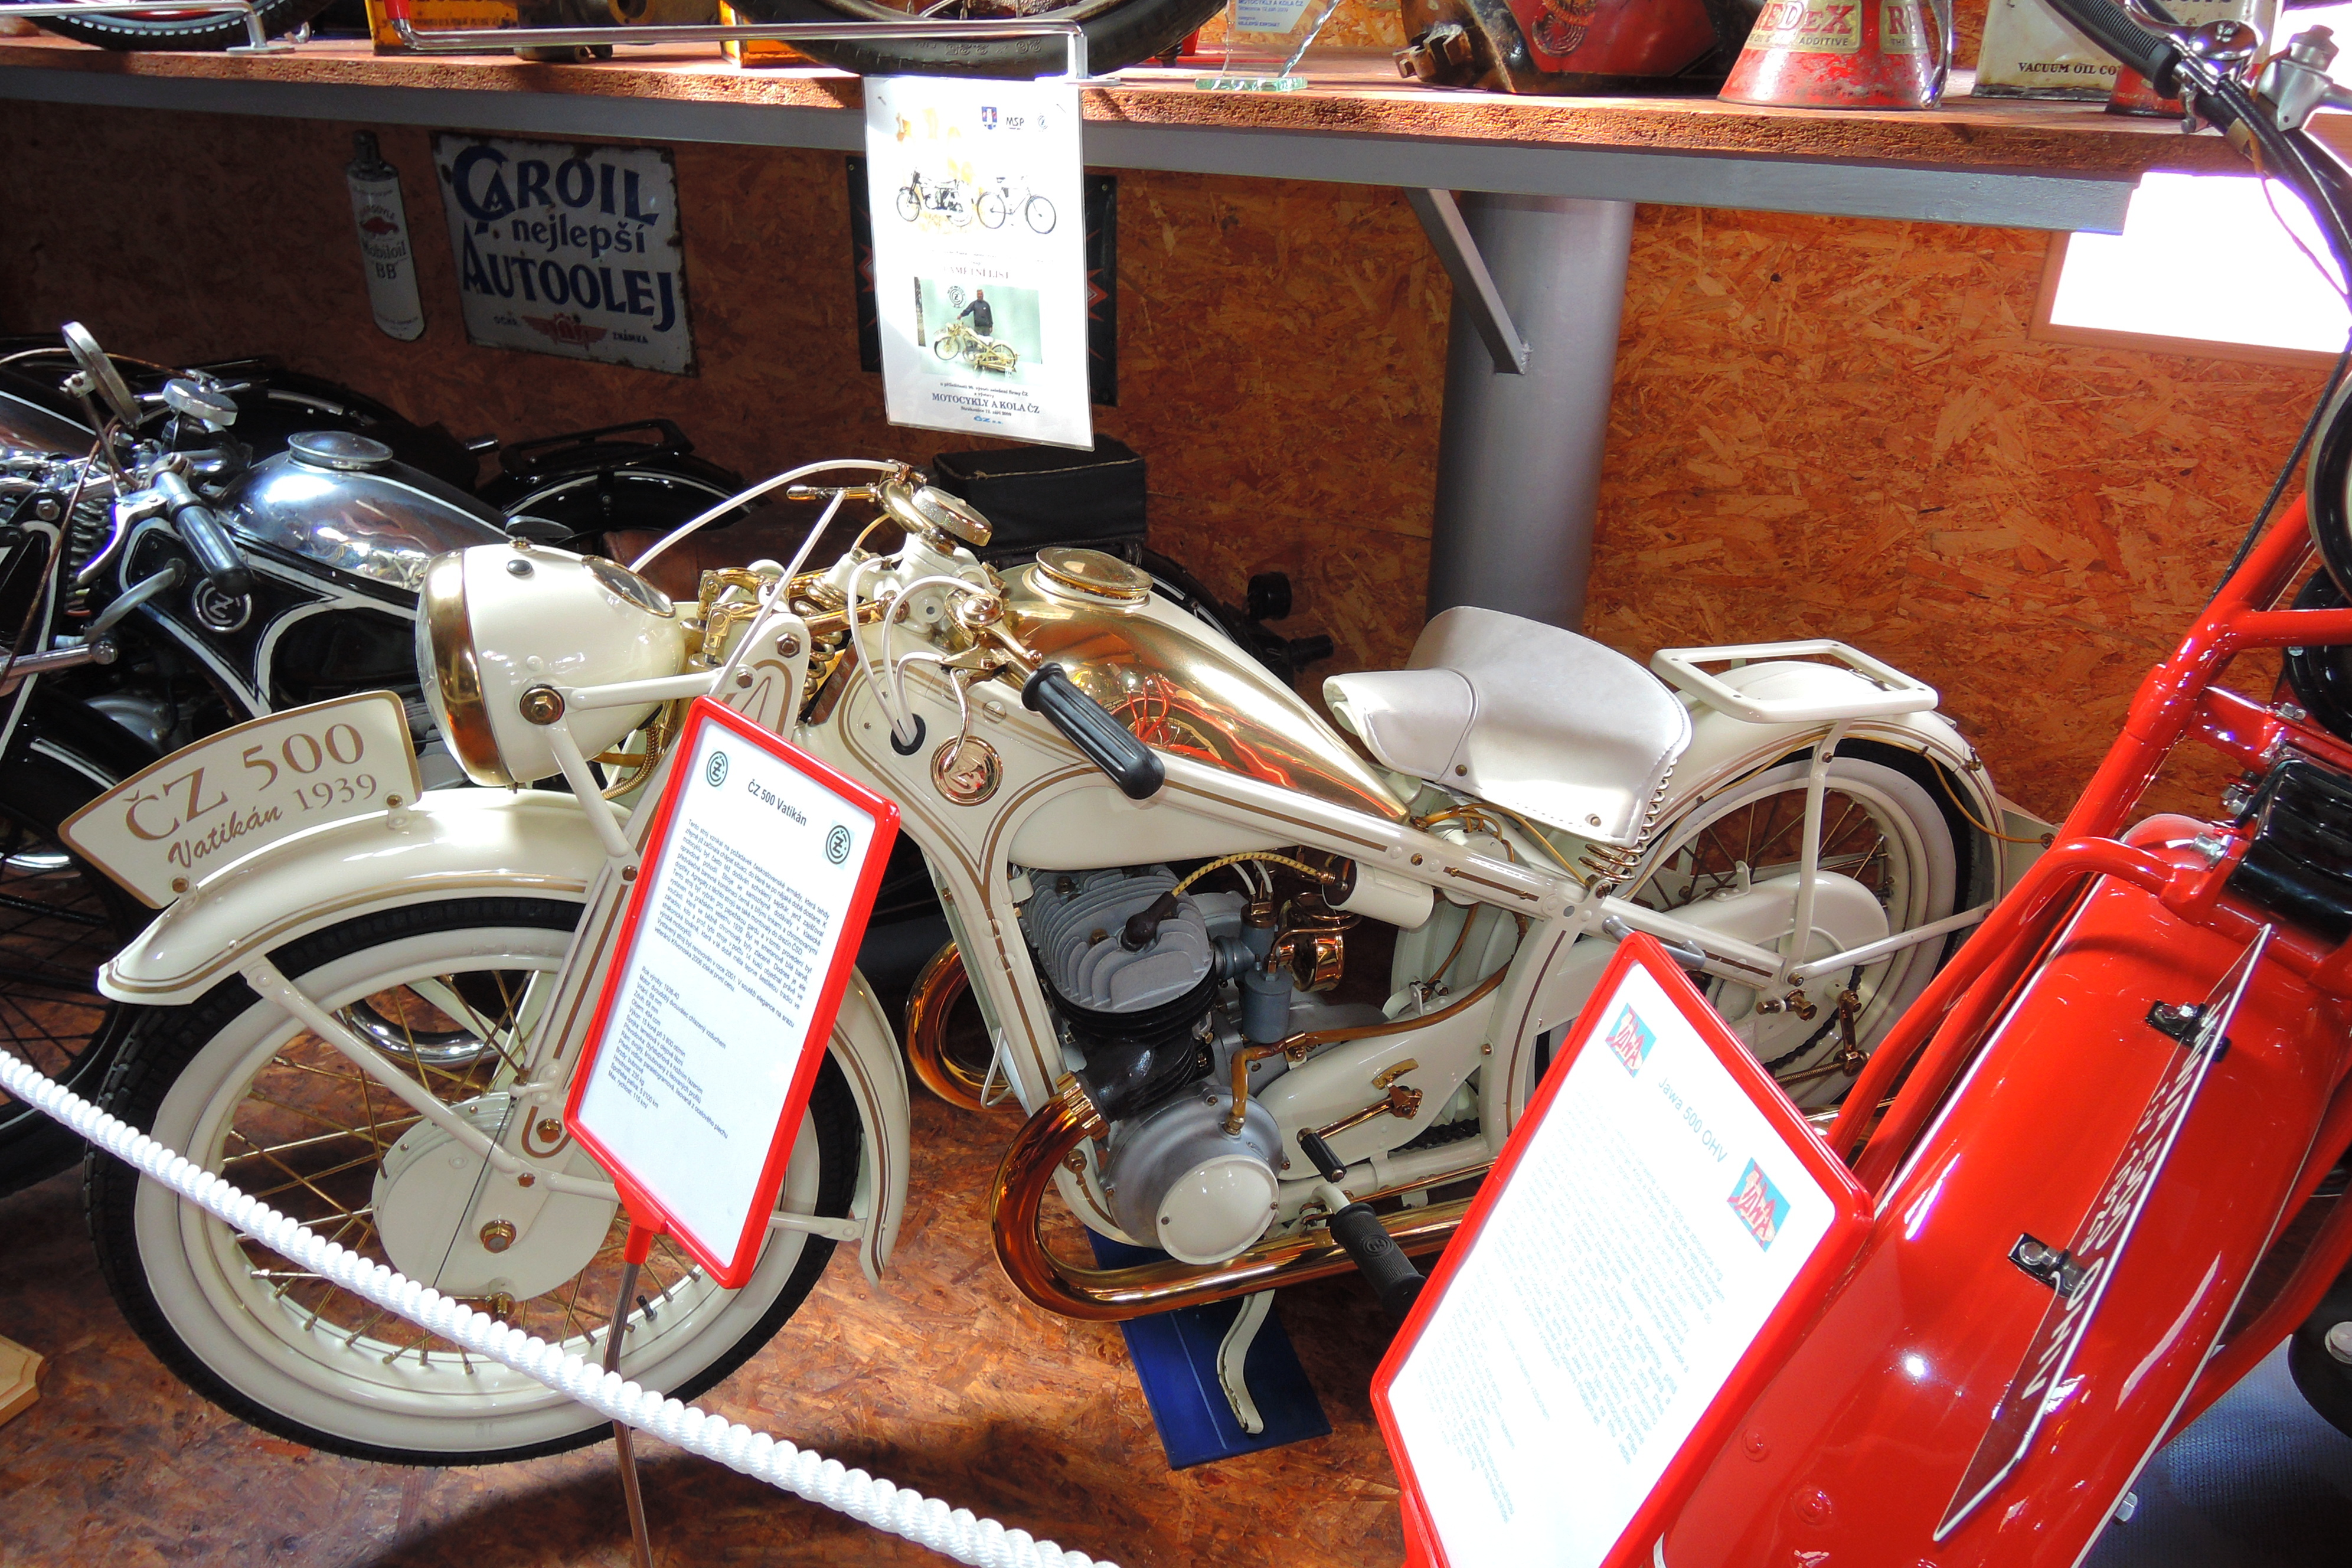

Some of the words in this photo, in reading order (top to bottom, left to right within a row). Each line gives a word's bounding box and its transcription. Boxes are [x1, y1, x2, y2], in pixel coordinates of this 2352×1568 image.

[1799, 37, 1849, 46] ADDITIVE
[2018, 63, 2069, 73] VACUUM
[2074, 63, 2096, 74] OIL
[452, 145, 659, 226] CAROIL
[375, 262, 397, 280] BB
[462, 221, 677, 332] AUTOOLEJ
[512, 213, 646, 260] nejlepší
[932, 393, 989, 407] MOTOCYKLY
[999, 401, 1026, 412] KOLA
[1027, 403, 1041, 414] ČZ
[122, 766, 228, 840] ČZ
[242, 723, 364, 791] 500
[168, 805, 283, 868] Vatikán
[292, 773, 377, 812] 1939
[747, 778, 761, 797] ČZ
[760, 788, 776, 806] 500
[776, 797, 807, 827] Vatikán
[2142, 991, 2230, 1151] JAWA
[1658, 1079, 1683, 1110] Jawa
[1683, 1106, 1702, 1133] 500
[1701, 1129, 1727, 1162] OHV
[2095, 1137, 2162, 1250] 500
[2021, 1257, 2104, 1400] OHV
